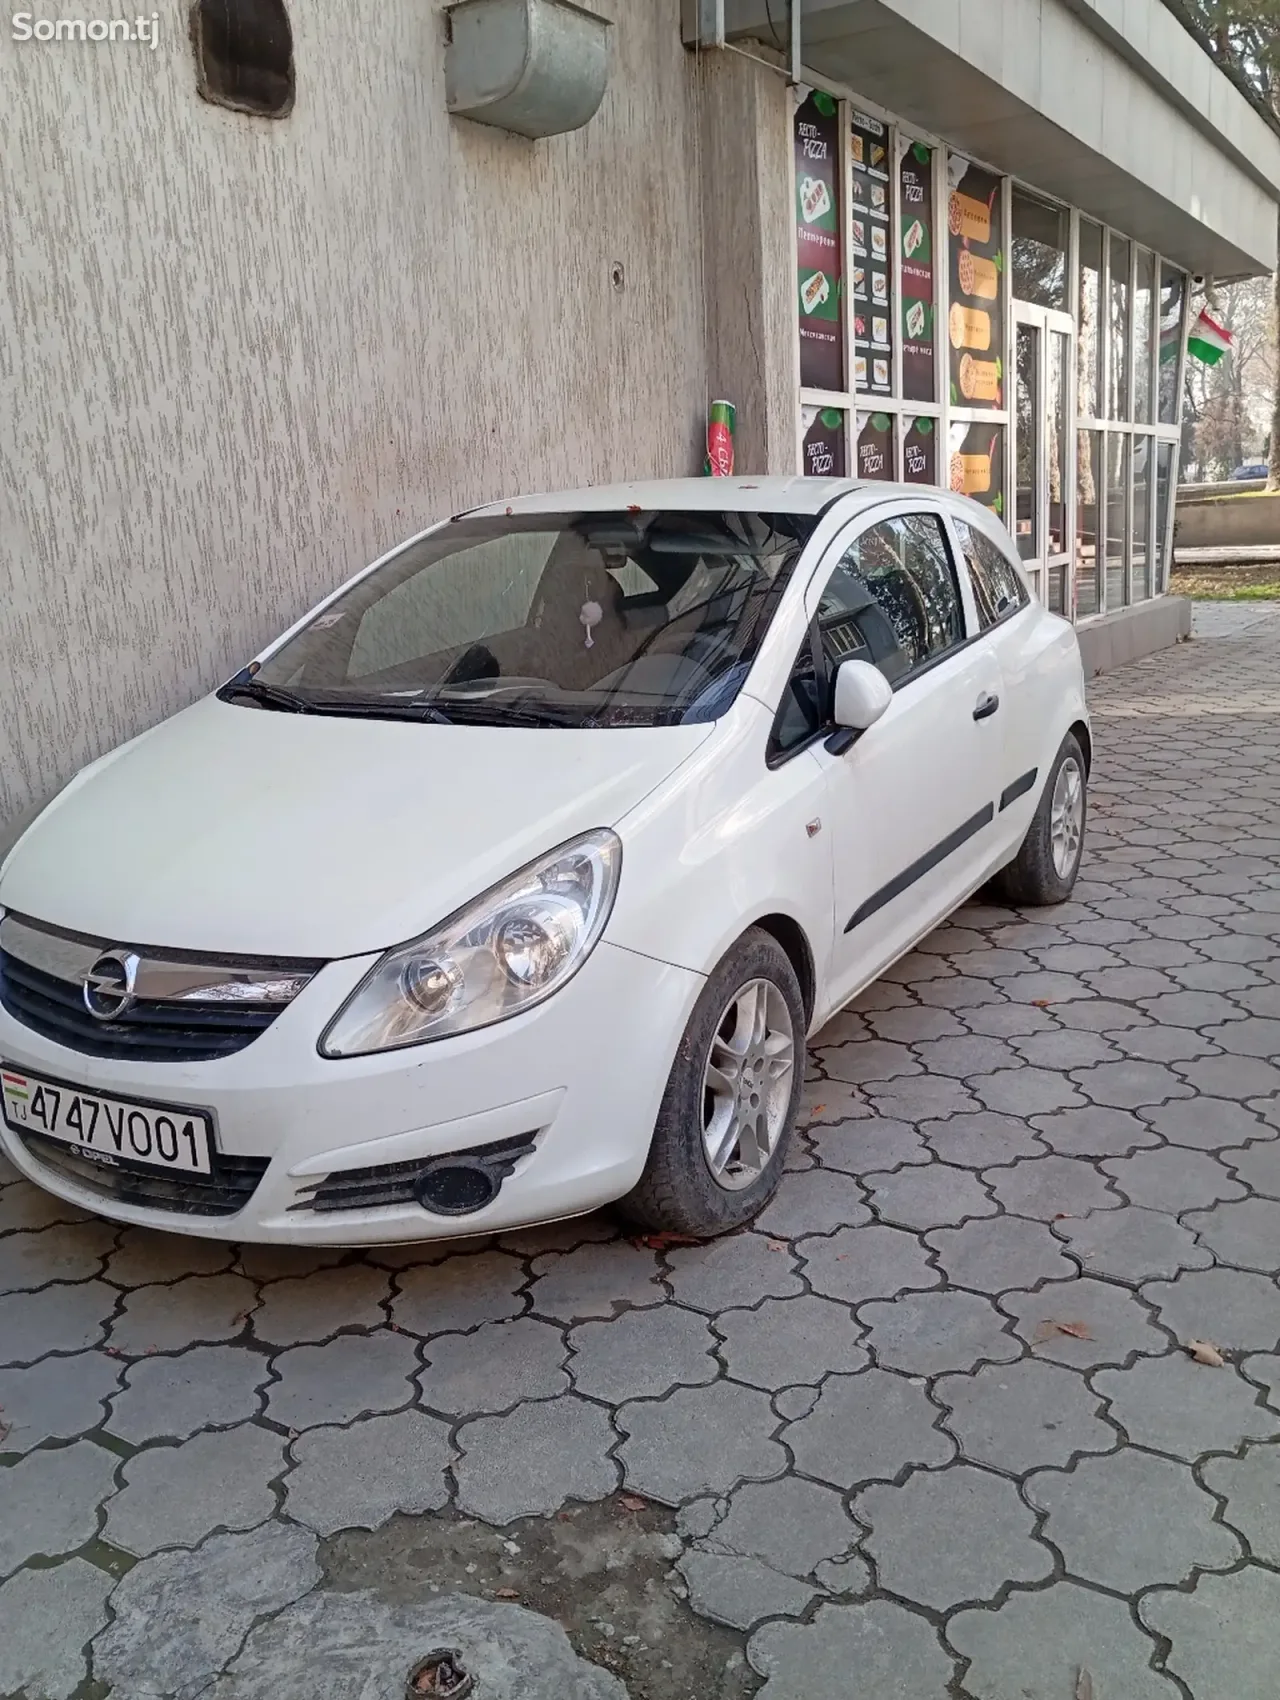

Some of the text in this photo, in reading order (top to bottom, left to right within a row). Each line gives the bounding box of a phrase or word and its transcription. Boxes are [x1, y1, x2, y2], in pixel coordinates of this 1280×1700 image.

[803, 138, 827, 160] PIZZA
[811, 453, 834, 474] PIZZA
[863, 453, 883, 474] PIZZA
[908, 455, 926, 473] PIZZA
[12, 1101, 28, 1121] TJ
[81, 1149, 120, 1167] OPEL
